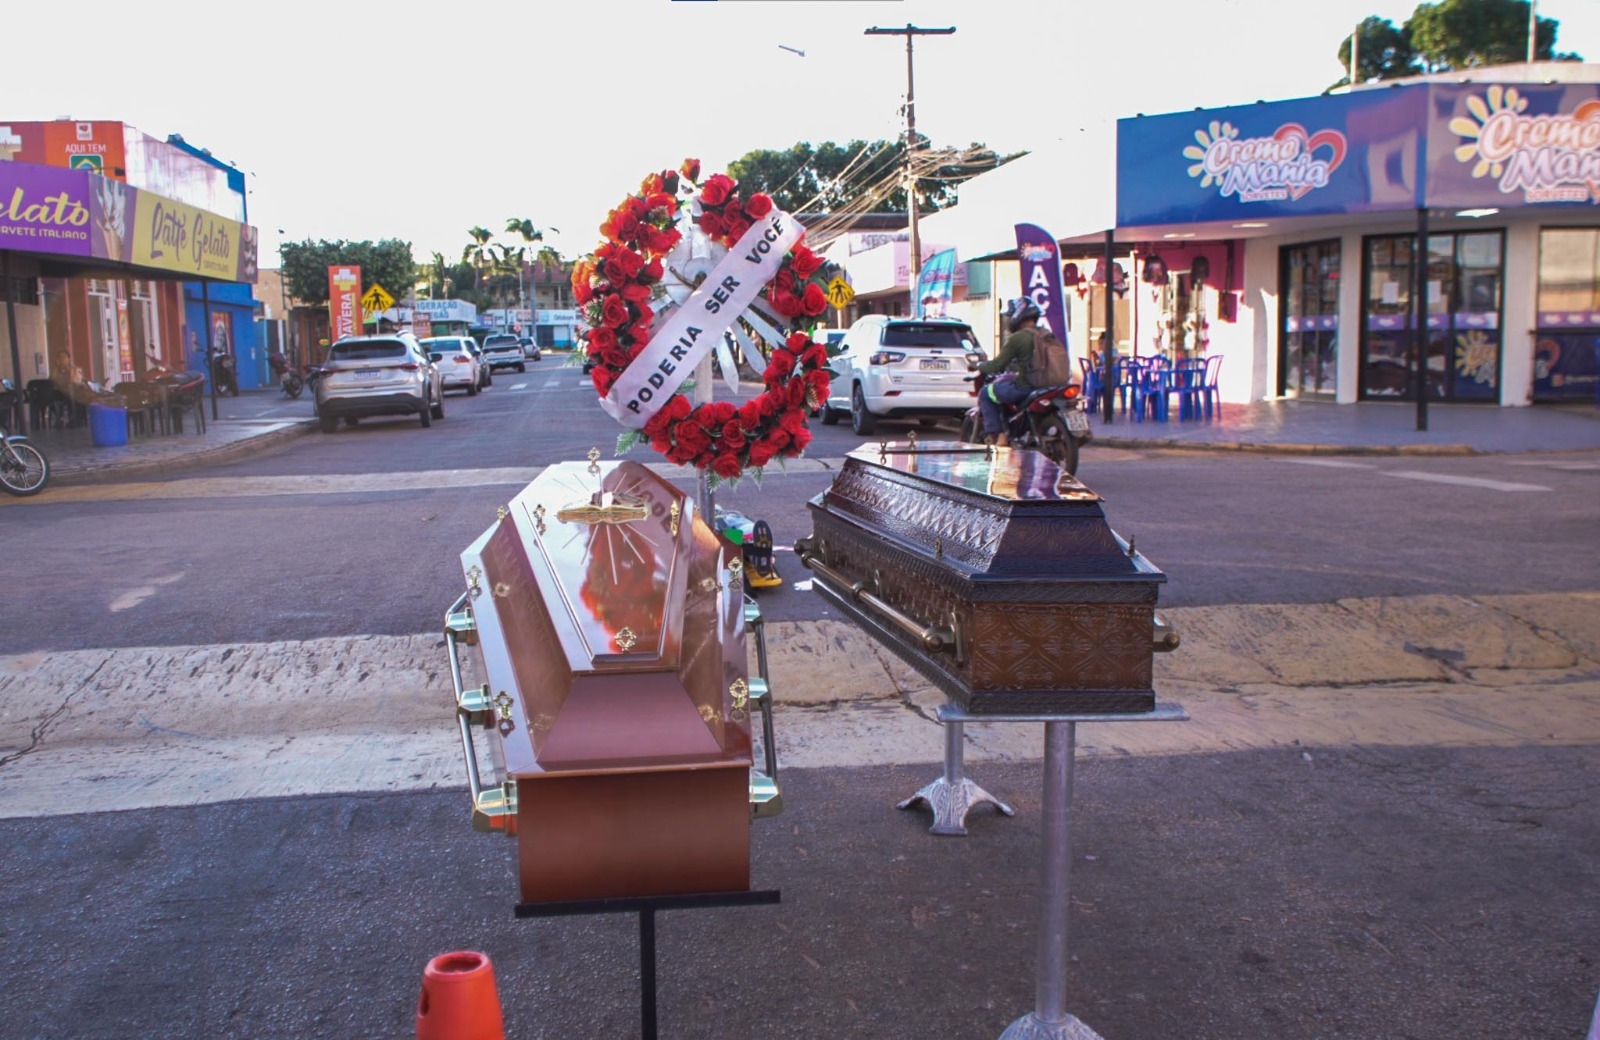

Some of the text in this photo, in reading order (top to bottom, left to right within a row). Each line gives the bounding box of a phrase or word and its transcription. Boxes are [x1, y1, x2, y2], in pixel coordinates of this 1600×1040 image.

[65, 144, 106, 154] AQUI TEM
[1203, 137, 1299, 175] Creme
[1479, 110, 1600, 162] Creme
[1221, 153, 1328, 196] Mania
[0, 186, 89, 226] lato
[39, 228, 87, 240] ITALIANO
[192, 212, 229, 271] Gelato
[626, 326, 703, 414] PODERIA
[705, 275, 741, 314] SER
